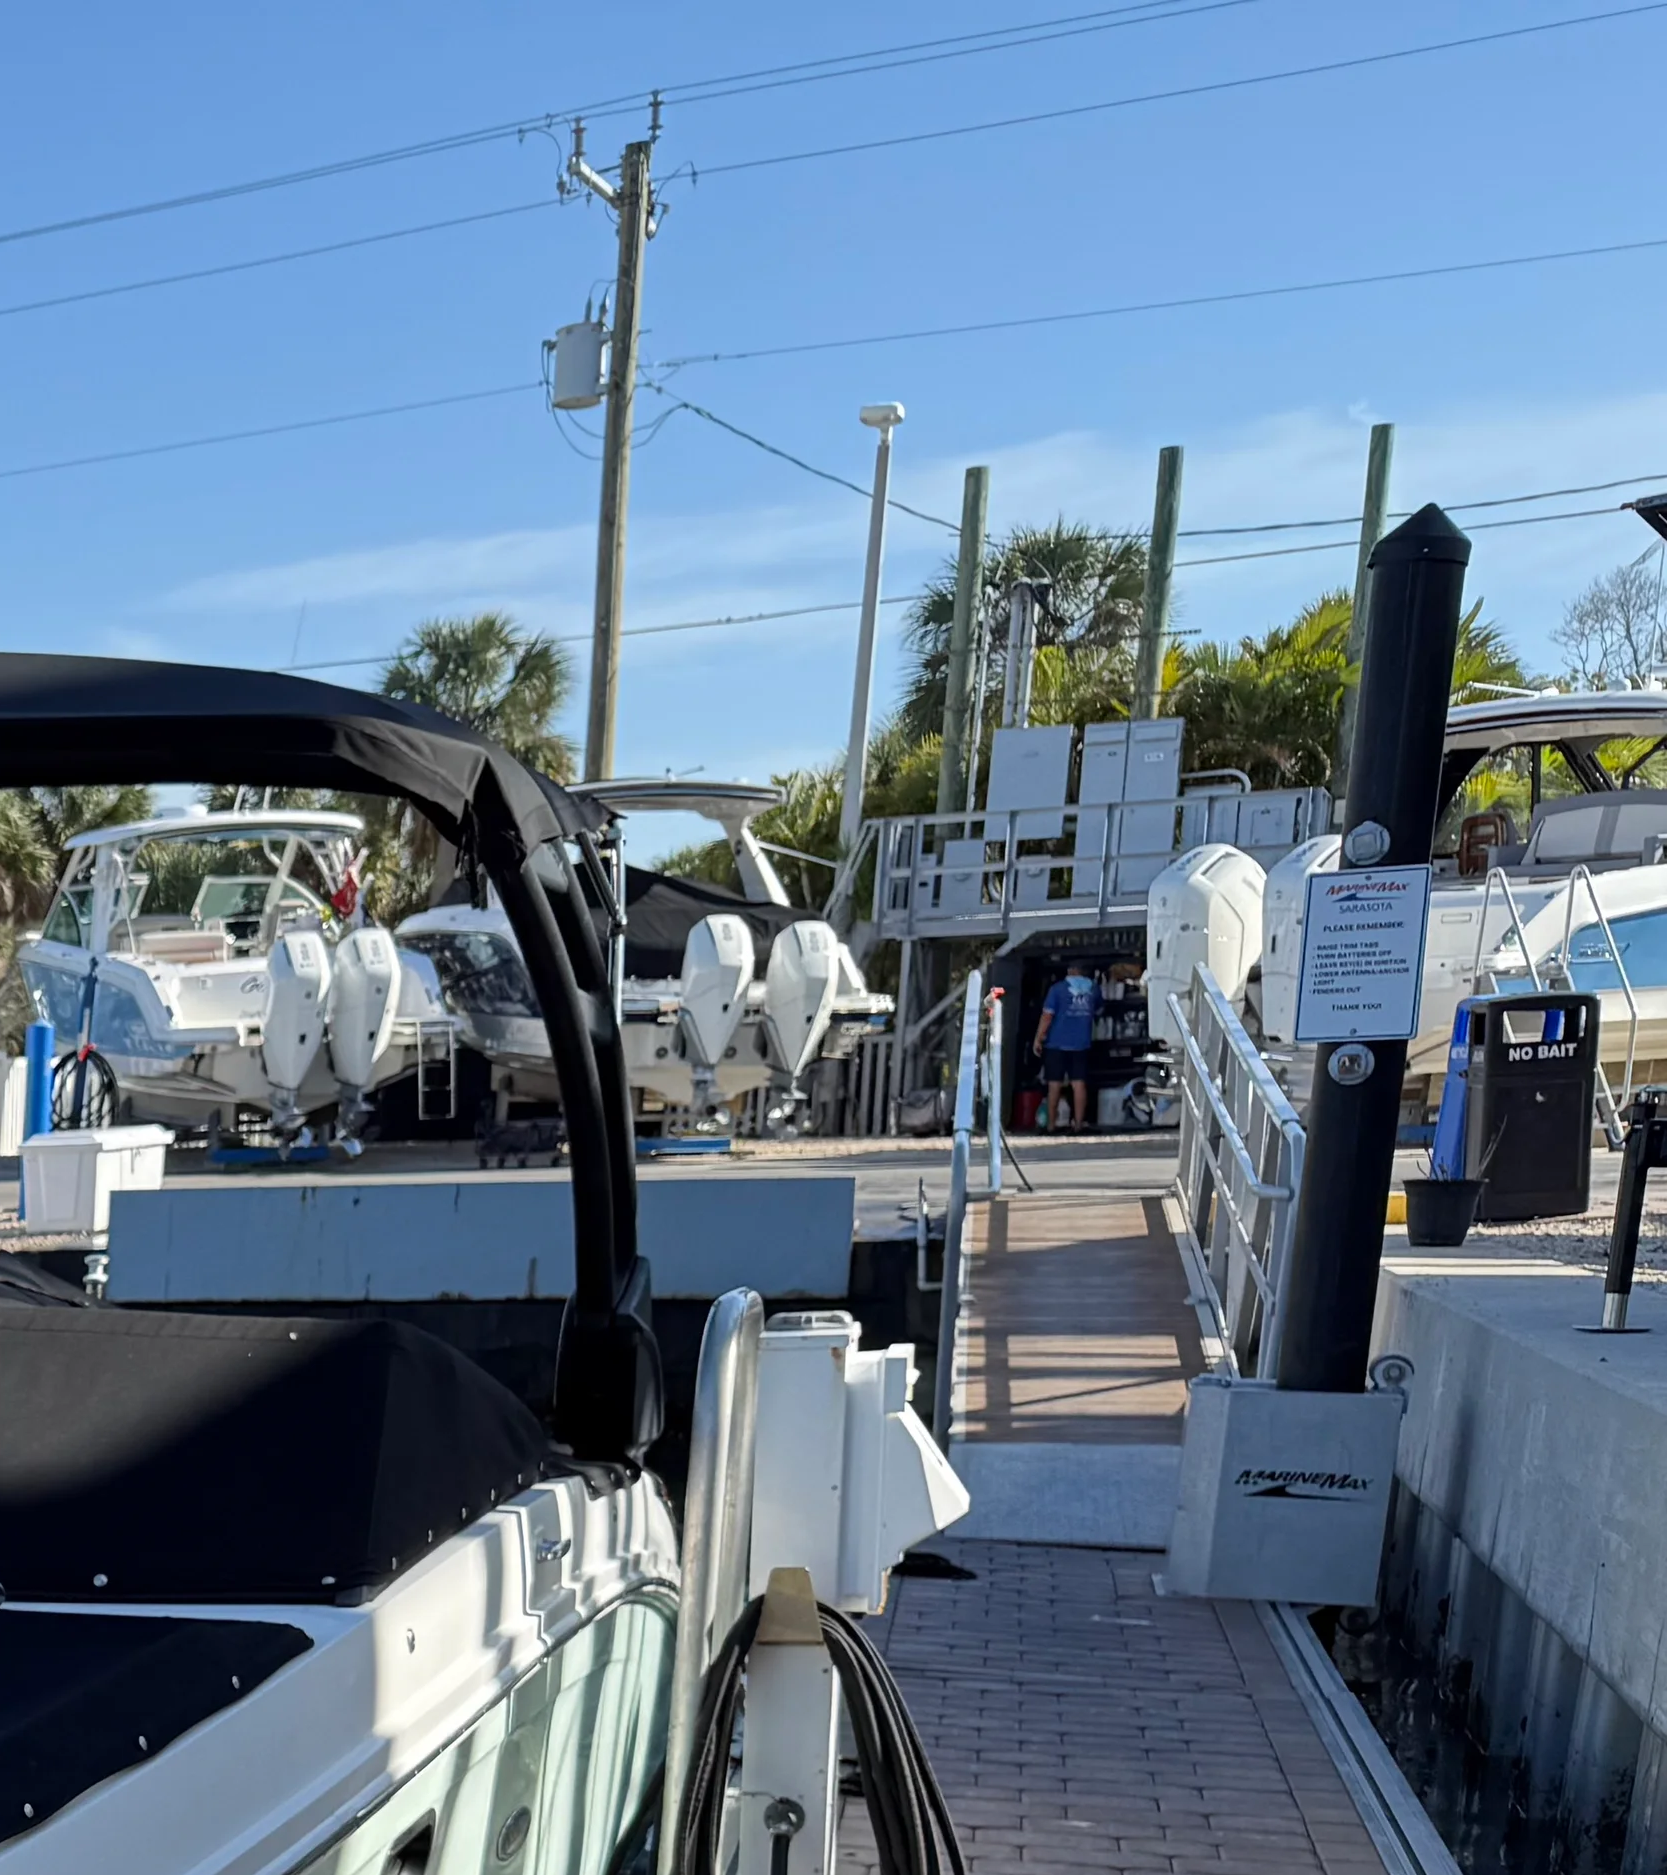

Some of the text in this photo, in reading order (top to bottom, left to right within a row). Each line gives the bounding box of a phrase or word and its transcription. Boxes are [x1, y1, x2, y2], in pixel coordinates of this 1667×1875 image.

[1338, 901, 1394, 914] SARASOTA
[1323, 922, 1354, 933] PLEASE
[1332, 1003, 1359, 1012] THANK
[1508, 1043, 1578, 1062] NO BAIT
